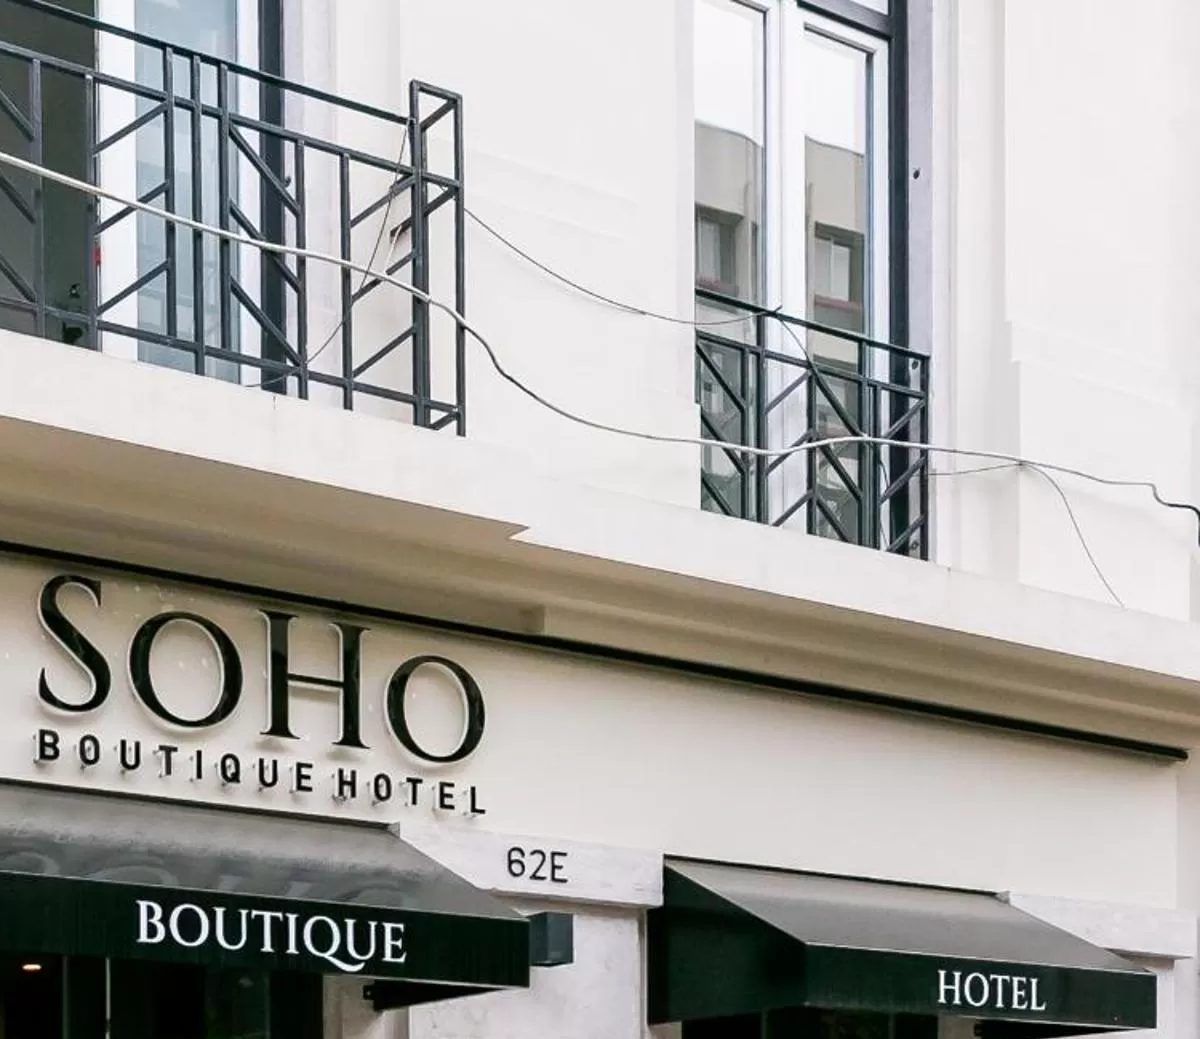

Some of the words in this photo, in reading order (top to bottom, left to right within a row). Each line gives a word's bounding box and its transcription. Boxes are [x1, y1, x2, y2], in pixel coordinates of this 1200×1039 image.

[38, 729, 314, 792] BOUTIQUE
[337, 768, 486, 815] HOTEL
[506, 846, 568, 883] 62E
[136, 900, 407, 972] BOUTIQUE
[937, 969, 1046, 1011] HOTEL
